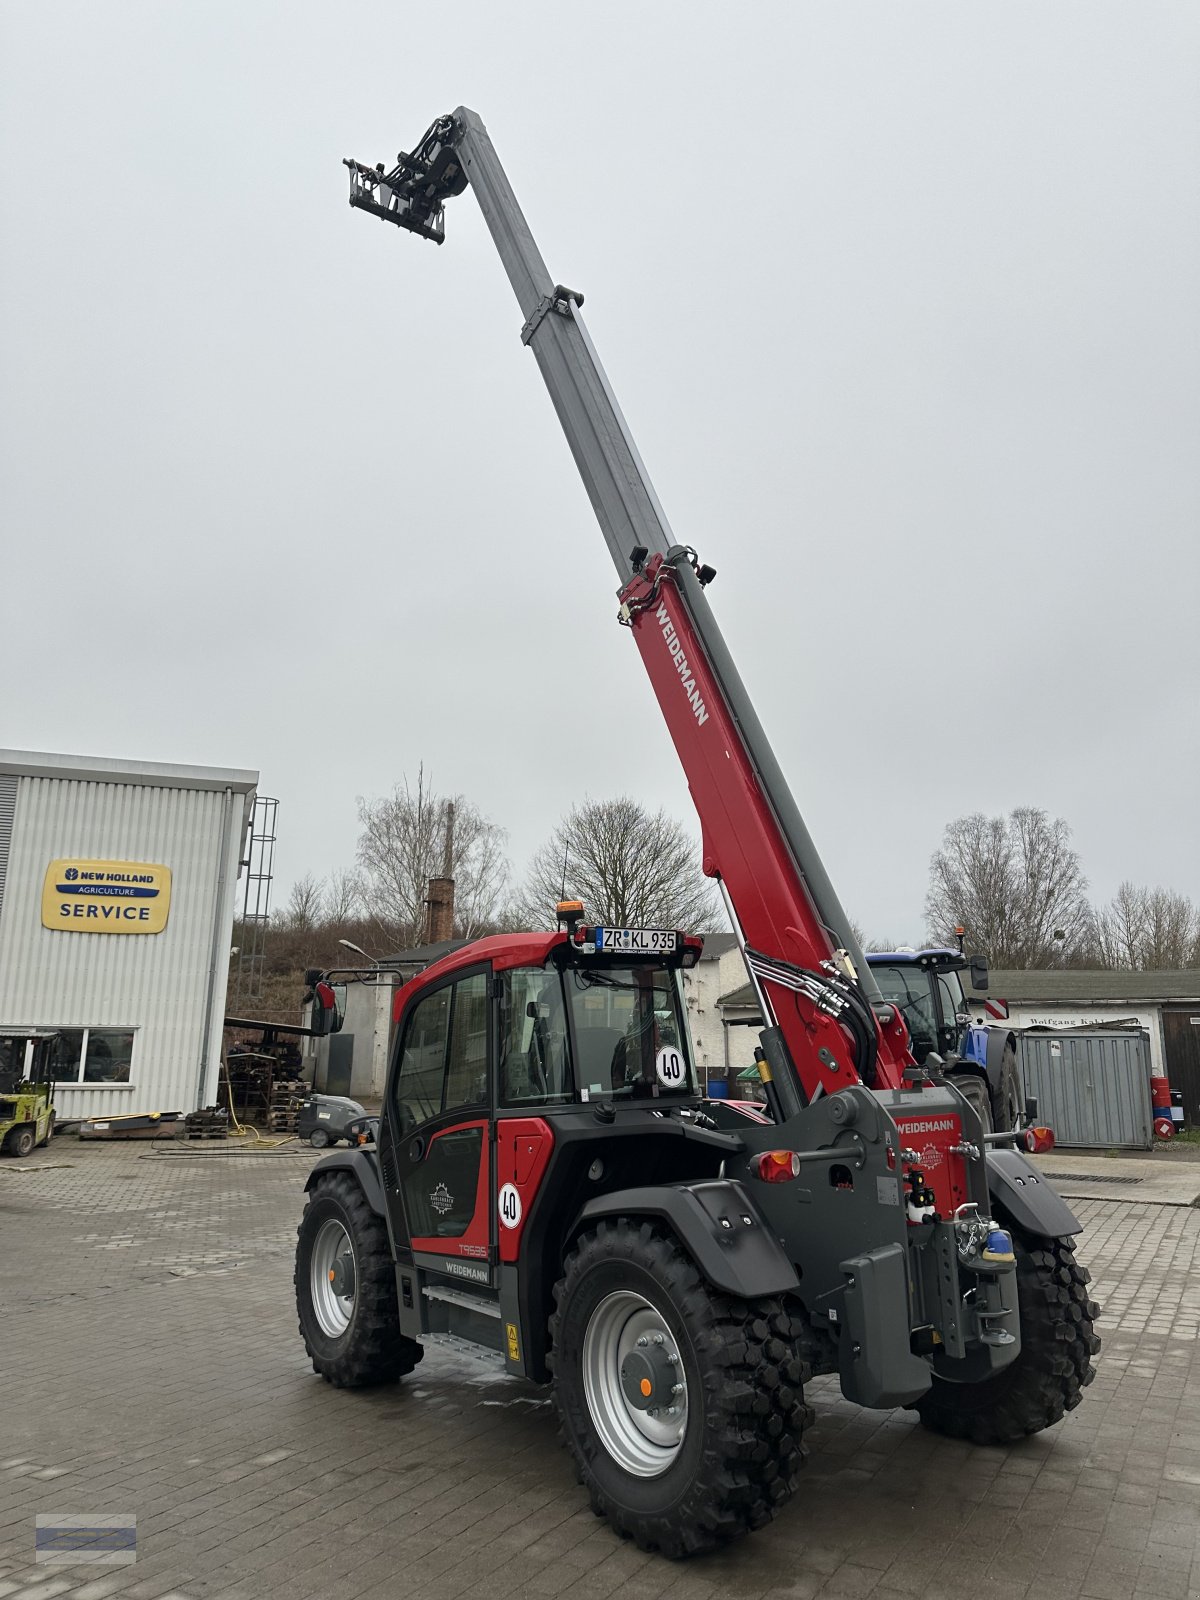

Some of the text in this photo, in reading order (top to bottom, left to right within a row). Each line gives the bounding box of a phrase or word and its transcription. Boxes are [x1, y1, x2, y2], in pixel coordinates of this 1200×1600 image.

[655, 600, 709, 726] WEIDEMANN
[80, 871, 154, 883] NEW HOLLAND
[78, 886, 135, 896] AGRICULTURE
[60, 903, 150, 920] SERVICE
[604, 930, 675, 949] ZR KL 935
[663, 1053, 680, 1079] 40
[897, 1120, 954, 1134] WEIDEMANN
[503, 1191, 516, 1220] 40
[459, 1244, 487, 1257] T9535
[446, 1262, 488, 1282] WEIDEMANN
